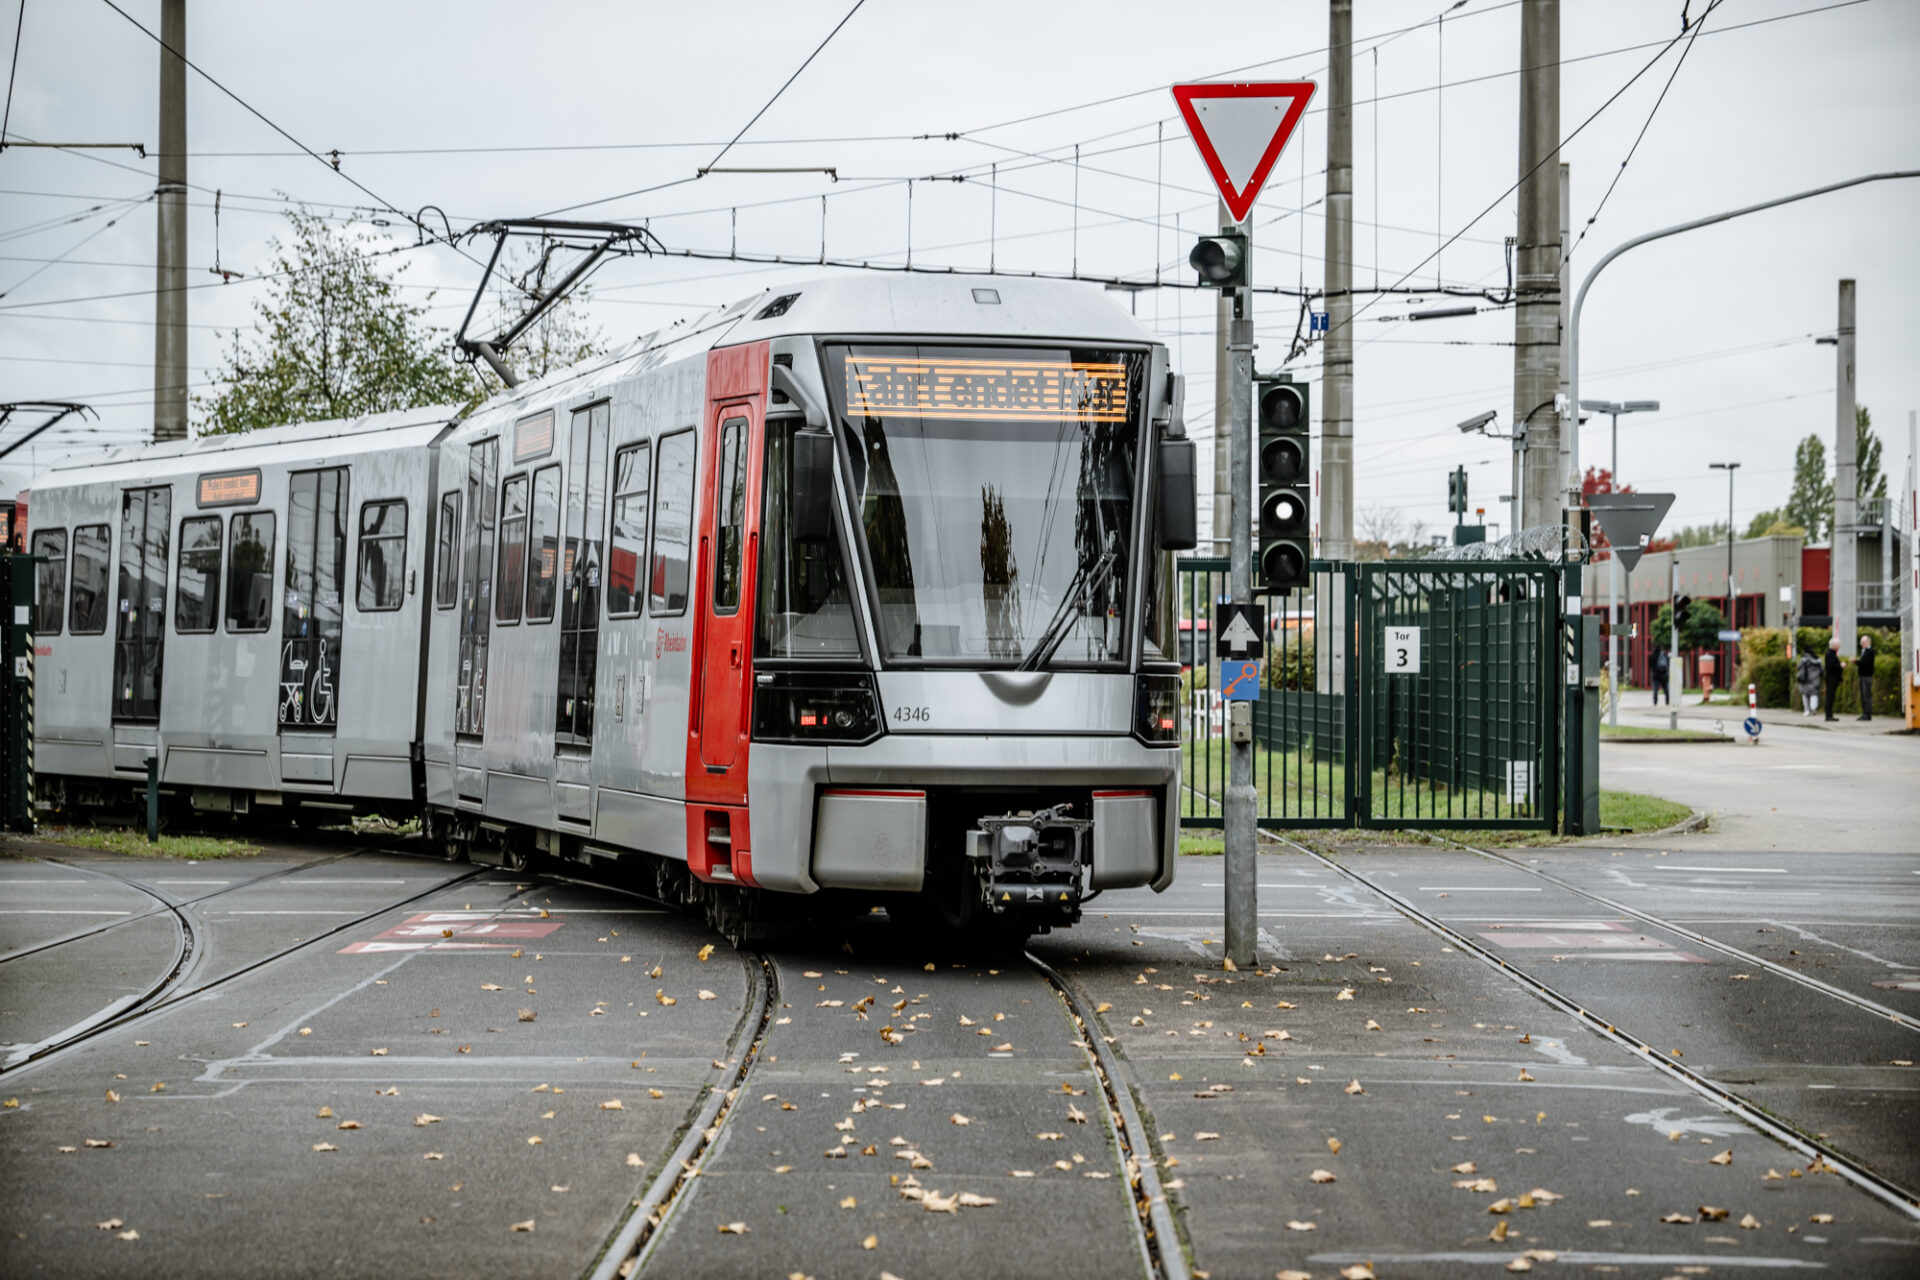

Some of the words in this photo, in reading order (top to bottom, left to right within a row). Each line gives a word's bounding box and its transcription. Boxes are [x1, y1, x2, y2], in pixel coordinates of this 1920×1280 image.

[948, 365, 1046, 410] endet
[1395, 631, 1410, 641] Tor
[1397, 648, 1408, 667] 3
[893, 707, 930, 722] 4346
